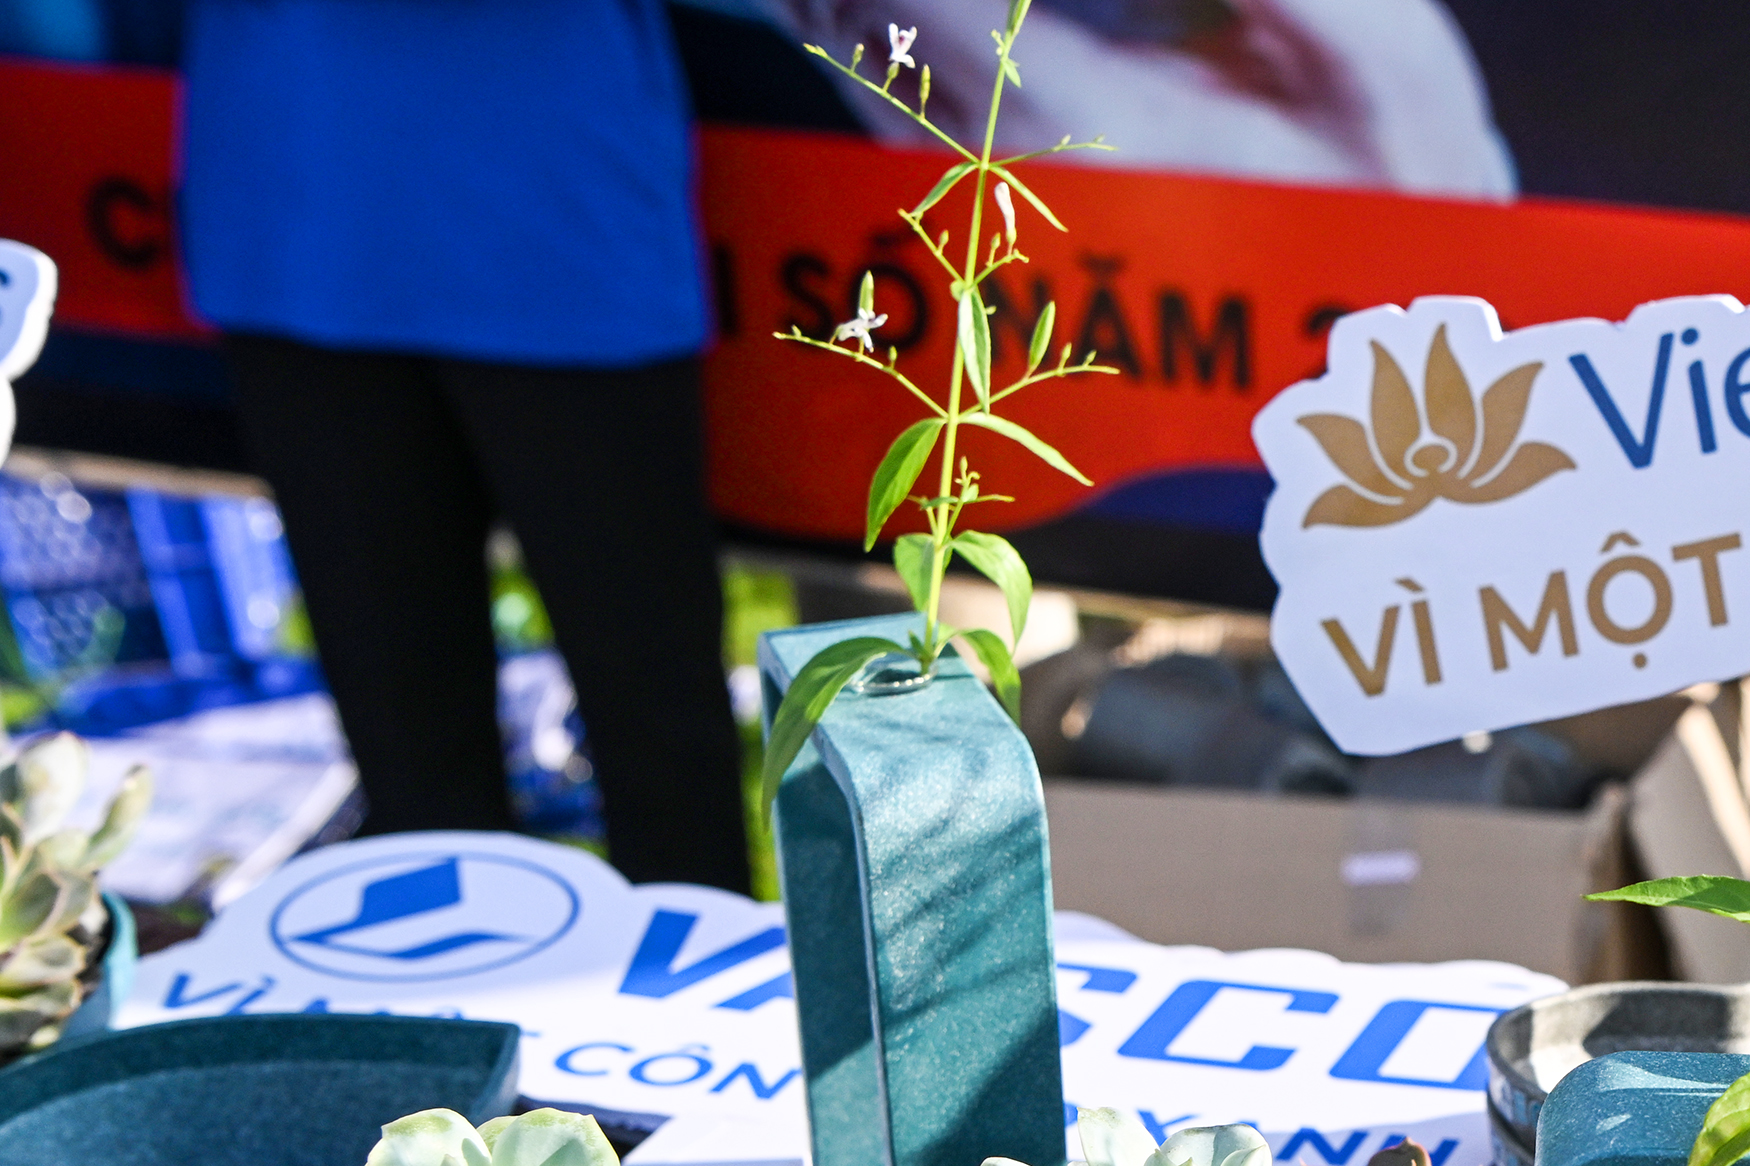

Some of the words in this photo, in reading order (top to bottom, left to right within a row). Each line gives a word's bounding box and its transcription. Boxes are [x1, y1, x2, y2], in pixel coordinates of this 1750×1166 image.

[1321, 577, 1442, 697] VÌ
[1479, 531, 1742, 670] MỘT
[554, 1042, 802, 1099] CÔN
